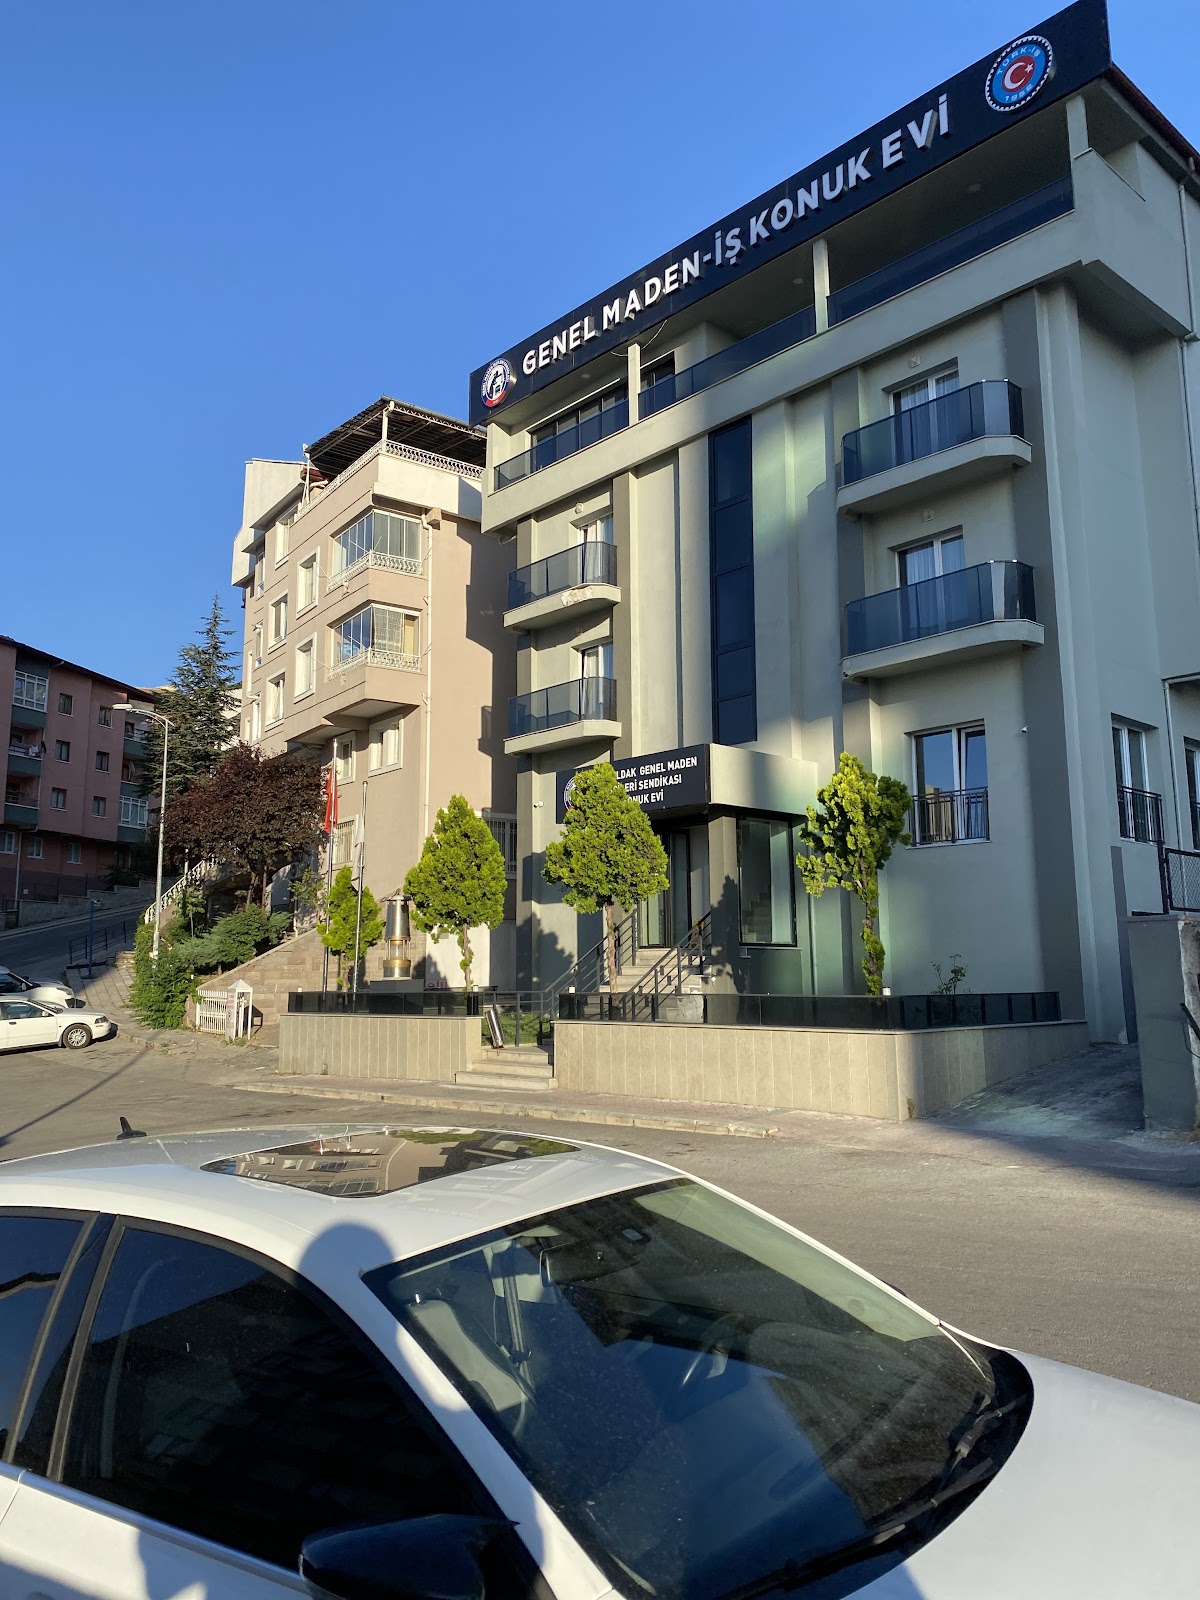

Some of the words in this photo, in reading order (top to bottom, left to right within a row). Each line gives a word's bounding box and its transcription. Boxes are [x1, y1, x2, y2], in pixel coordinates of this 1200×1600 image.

[522, 316, 596, 375] GENEL
[602, 227, 742, 329] MADEN-İŞ
[750, 147, 872, 246] KONUK
[882, 93, 949, 169] EVİ
[615, 767, 637, 780] LDAK
[640, 762, 666, 776] GENEL
[667, 756, 698, 771] MADEN
[638, 773, 682, 790] SENDİKASI
[651, 789, 664, 803] EVİ
